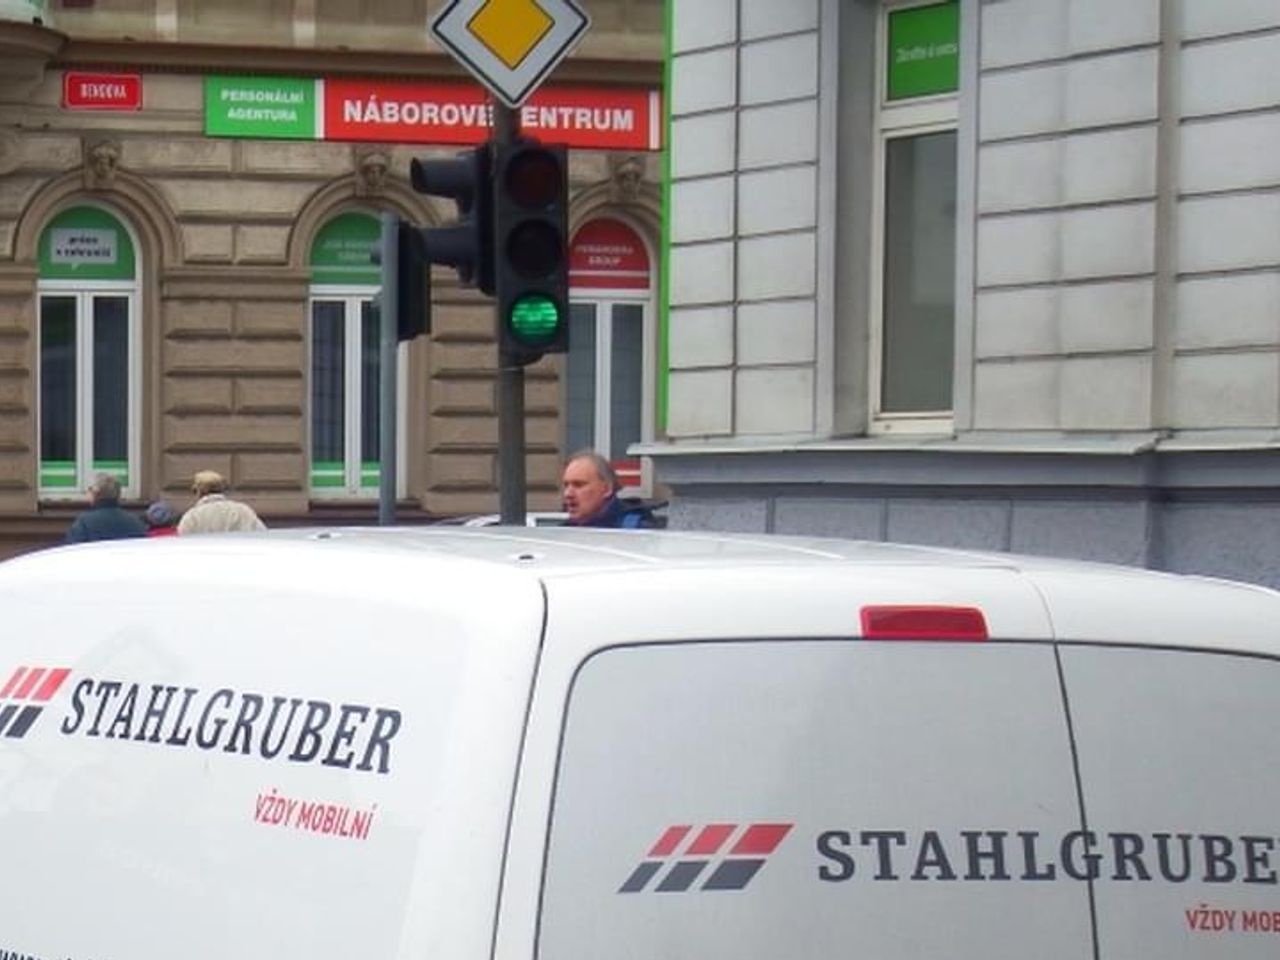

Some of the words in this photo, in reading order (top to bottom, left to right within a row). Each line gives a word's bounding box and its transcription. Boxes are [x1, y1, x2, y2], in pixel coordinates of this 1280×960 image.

[518, 106, 634, 131] ENTRUM
[61, 677, 403, 775] STAHLGRUBER
[254, 788, 298, 827] VŽDY
[295, 801, 378, 840] MOBILNÍ
[816, 830, 1280, 884] STAHLGRUBE
[1185, 903, 1236, 931] VŽDY
